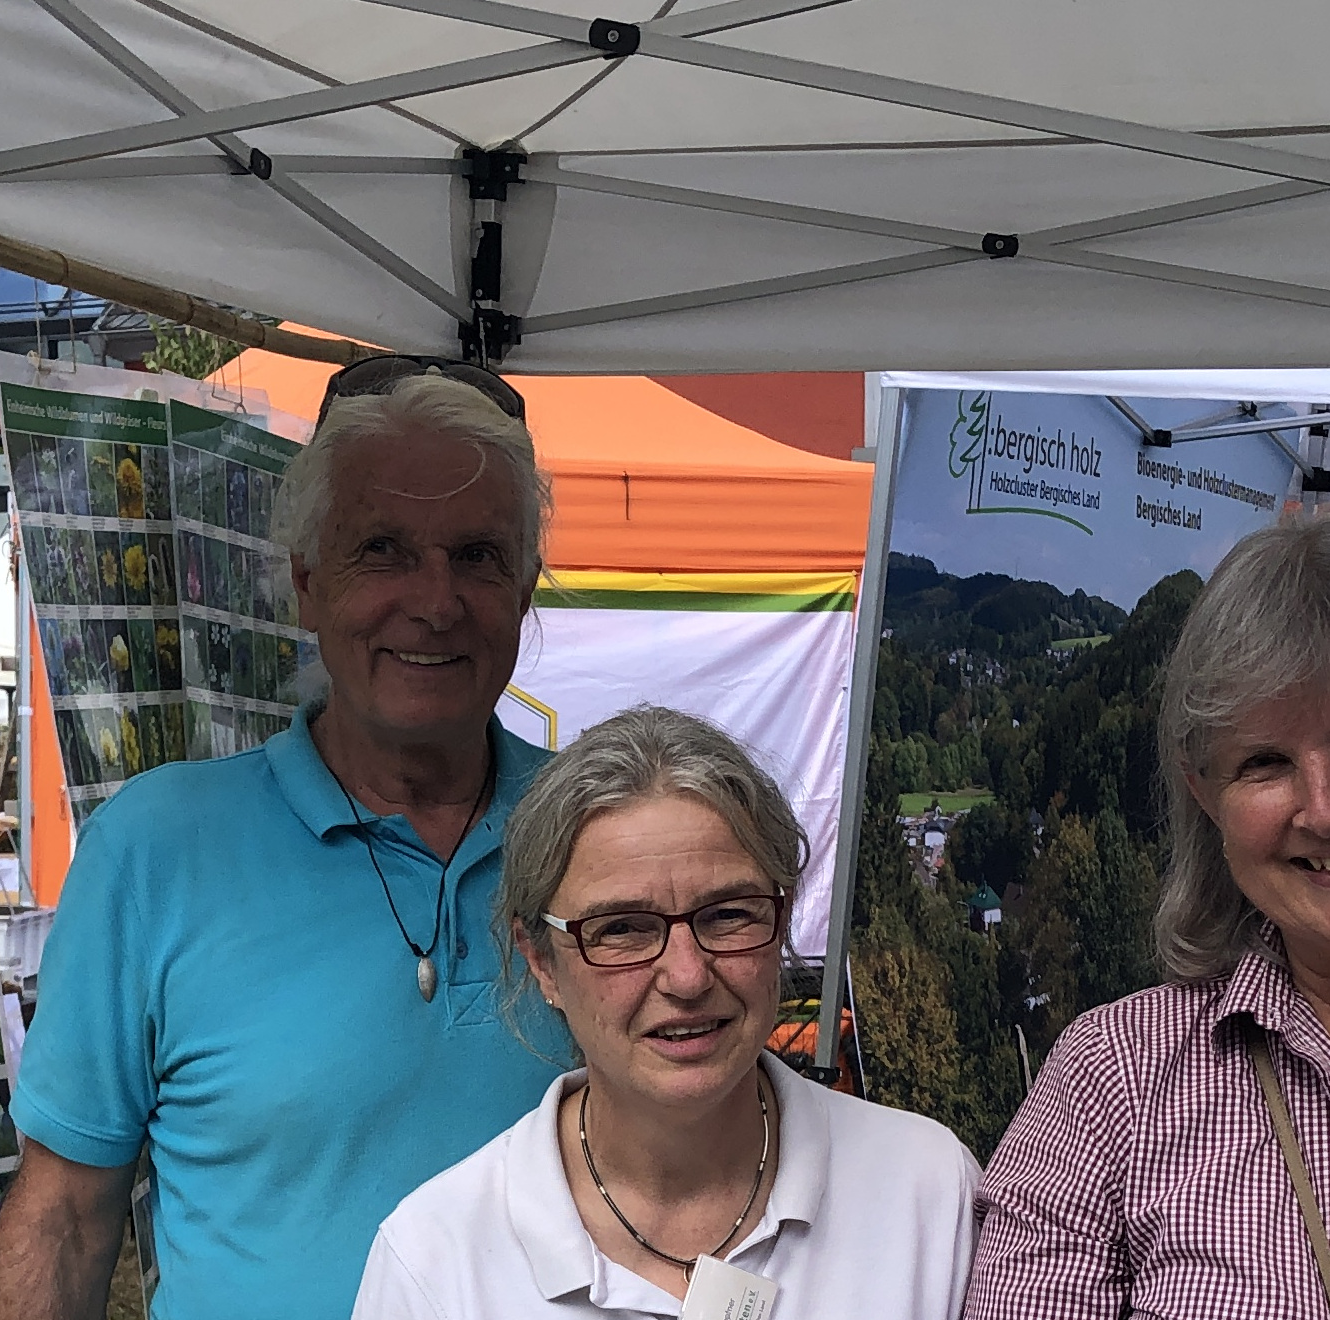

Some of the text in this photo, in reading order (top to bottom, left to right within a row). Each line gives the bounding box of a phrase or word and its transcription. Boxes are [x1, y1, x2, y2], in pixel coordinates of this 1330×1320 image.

[1069, 431, 1103, 478] holz
[1136, 451, 1187, 490] Bioenergie-
[1187, 467, 1204, 490] und
[989, 470, 1102, 511] Holzcluster Bergisches Land
[1136, 494, 1202, 532] Bergisches Land
